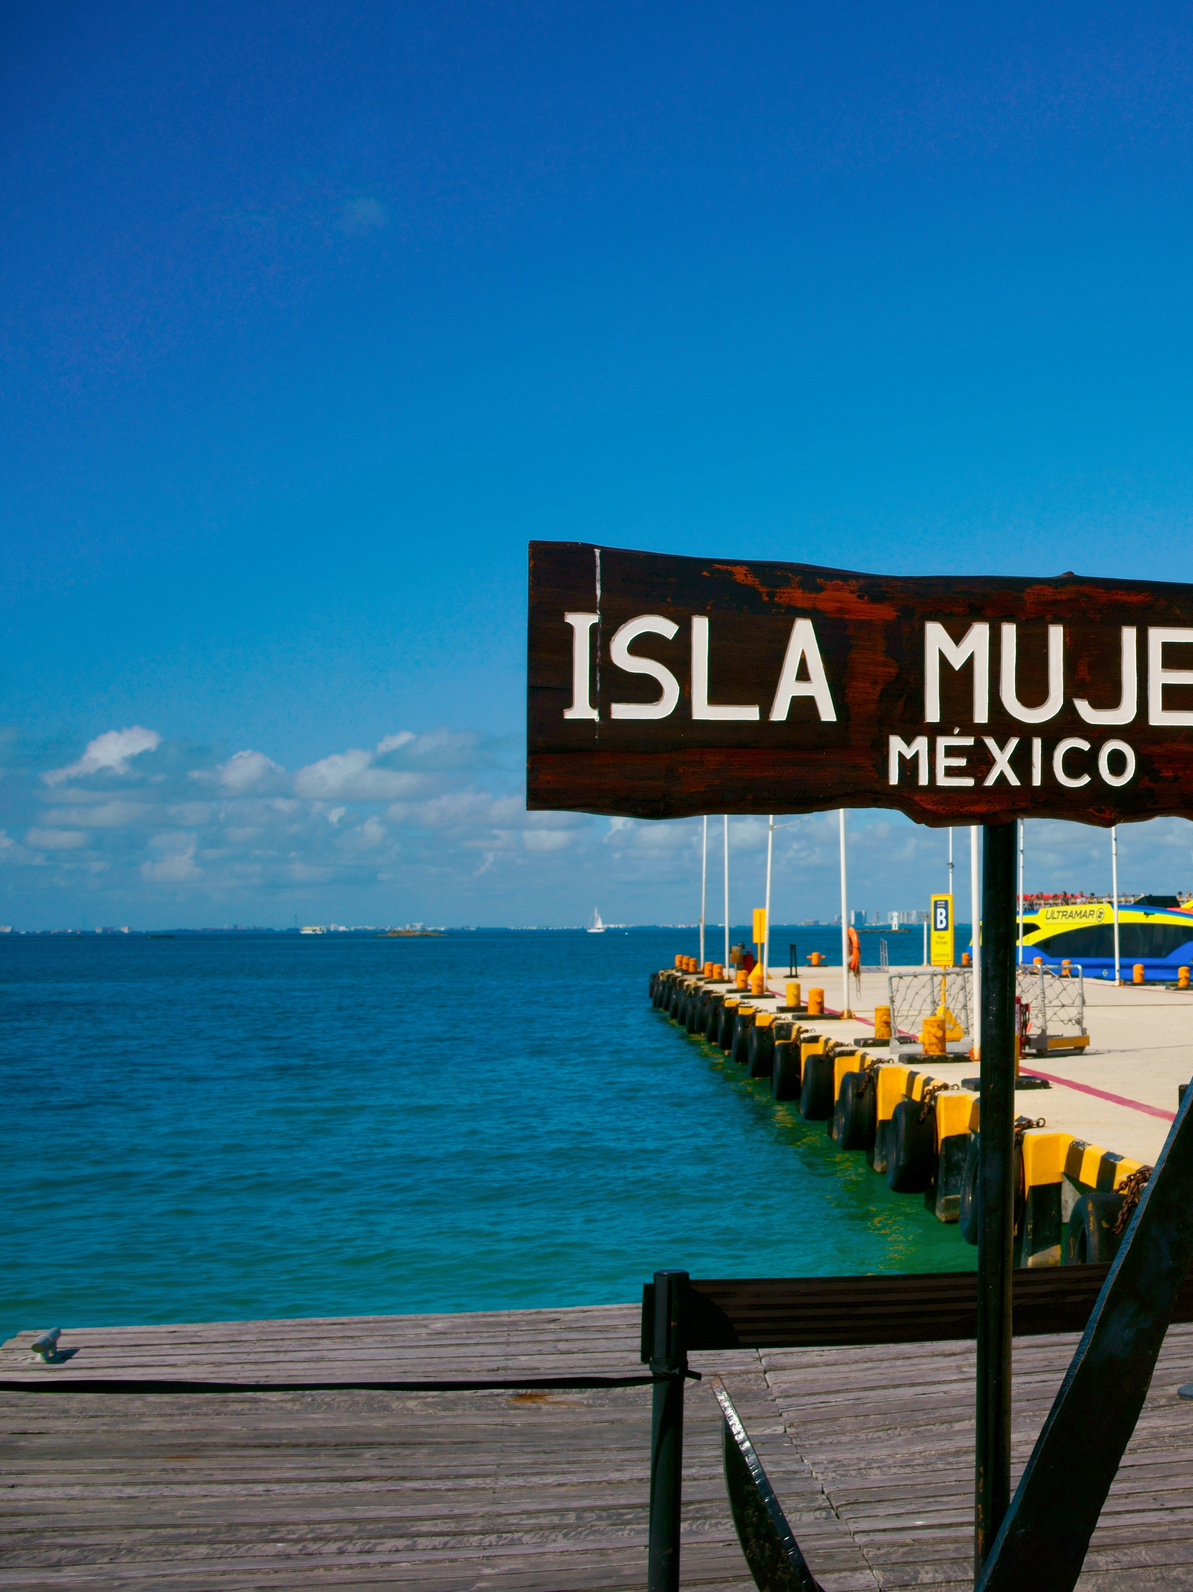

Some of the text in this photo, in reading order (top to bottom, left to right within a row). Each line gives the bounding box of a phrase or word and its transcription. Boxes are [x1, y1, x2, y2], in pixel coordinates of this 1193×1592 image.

[563, 611, 838, 724] ISLA
[887, 727, 1137, 788] MÉXICO
[936, 908, 946, 928] B
[1045, 910, 1095, 920] ULTRAMAR
